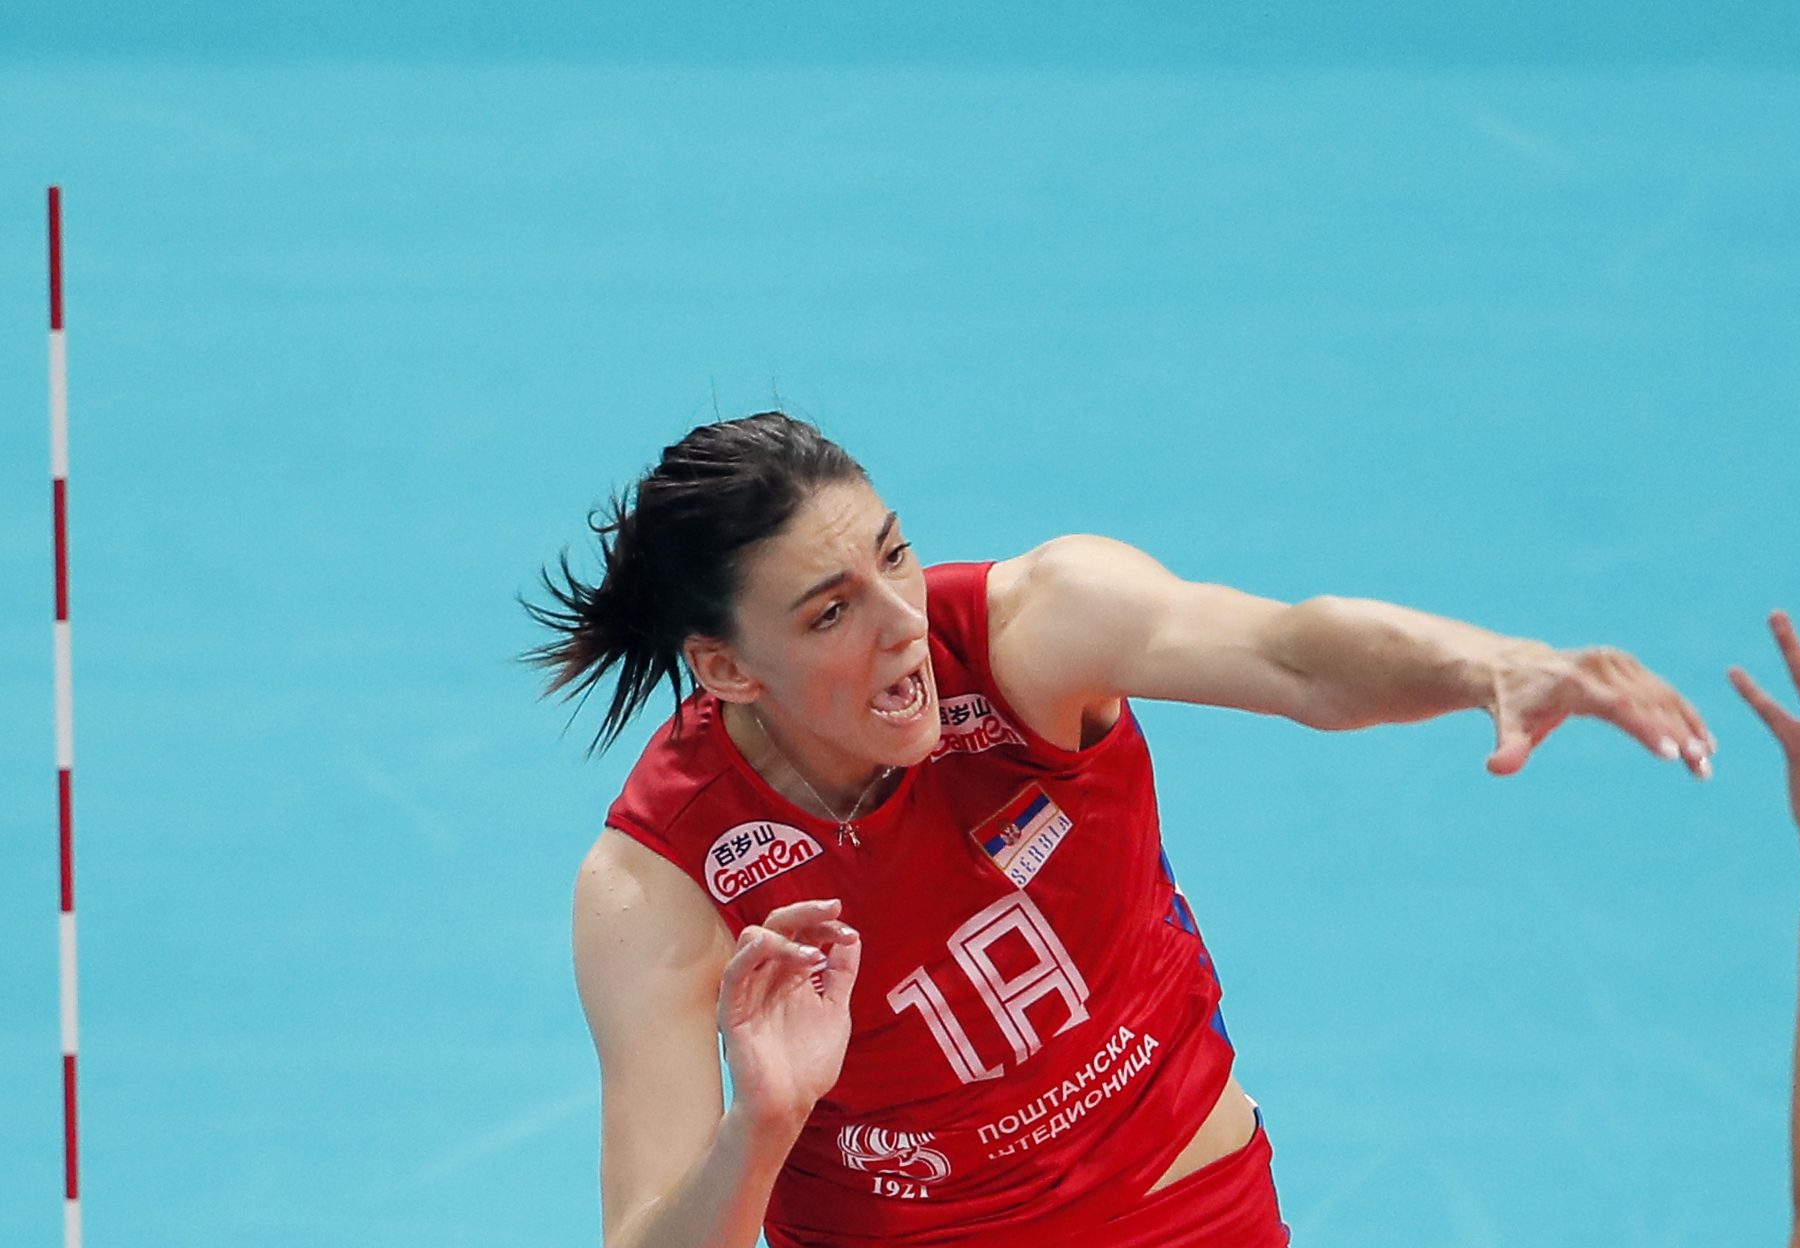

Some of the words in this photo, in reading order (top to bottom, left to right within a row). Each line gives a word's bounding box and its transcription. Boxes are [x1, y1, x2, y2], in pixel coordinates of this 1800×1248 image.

[711, 824, 776, 867] 百岁山
[1011, 815, 1070, 885] SERBIA
[977, 1025, 1135, 1144] ПОШТАНСКА
[872, 1176, 929, 1199] 1921
